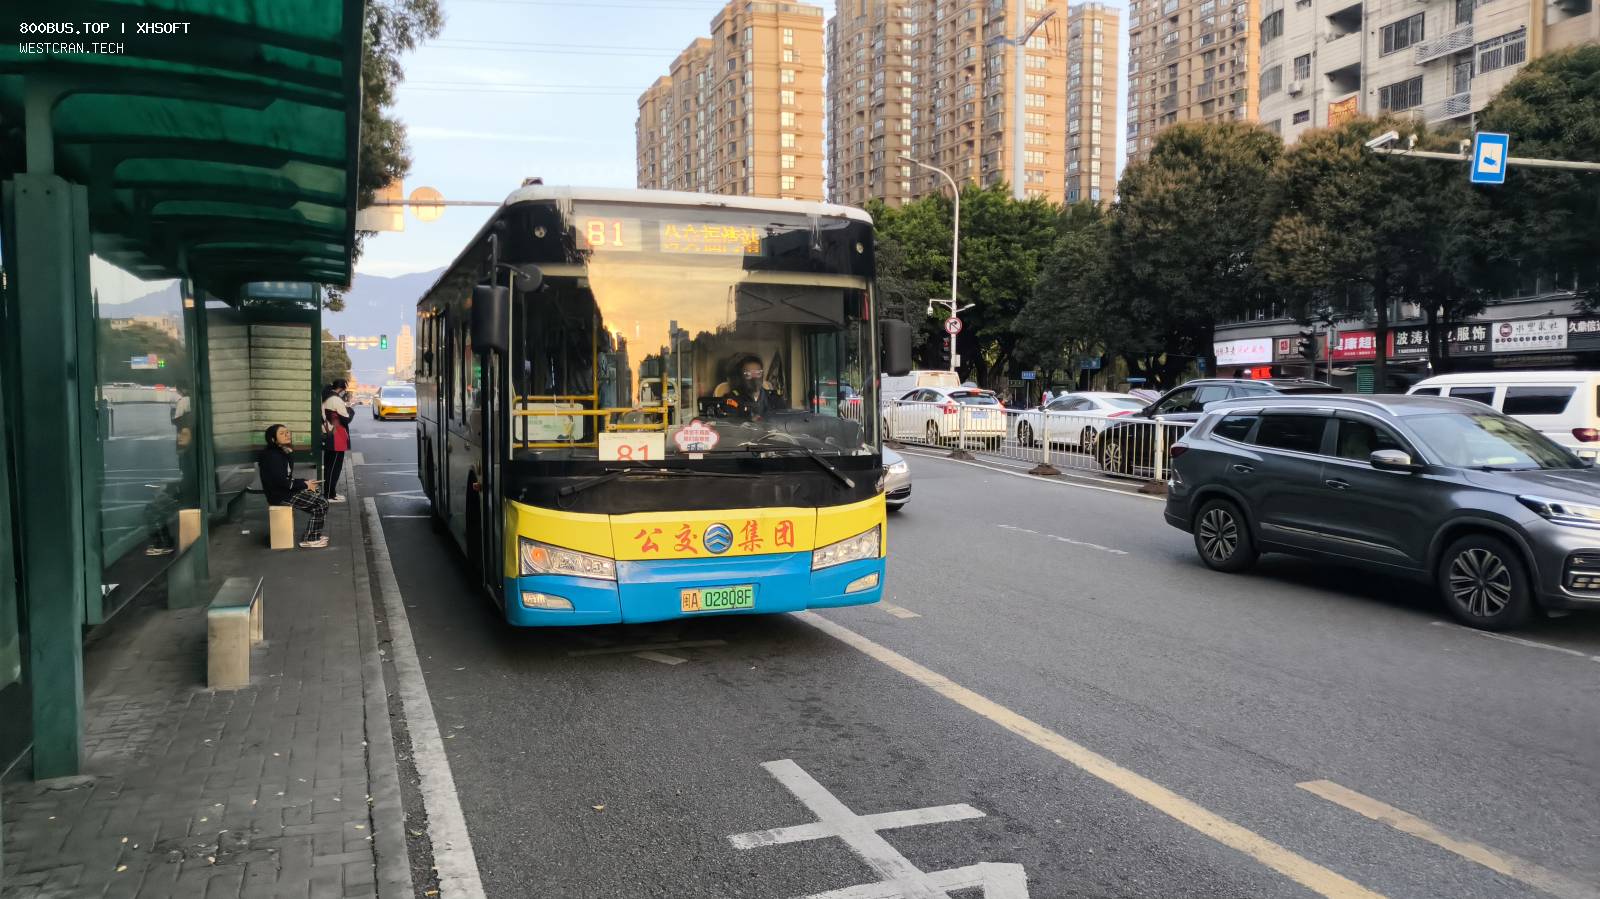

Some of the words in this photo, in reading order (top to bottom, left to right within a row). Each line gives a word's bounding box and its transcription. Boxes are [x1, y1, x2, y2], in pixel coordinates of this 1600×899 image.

[586, 219, 624, 247] 81
[617, 444, 649, 461] 81
[634, 520, 794, 554] 公交集团
[705, 589, 752, 607] 02808F
